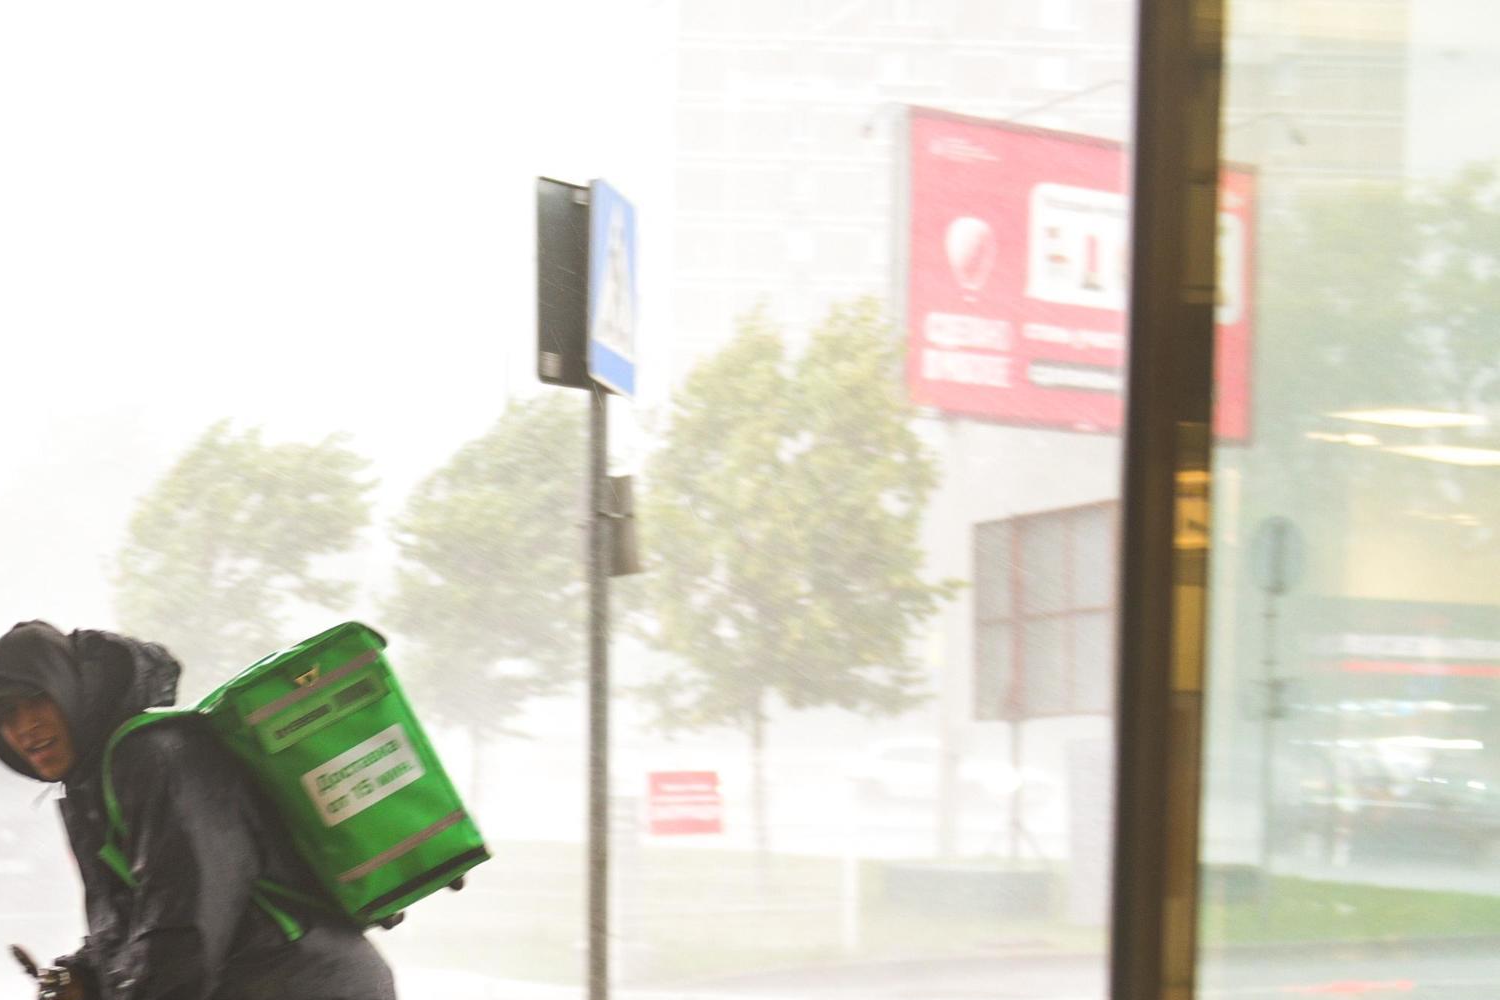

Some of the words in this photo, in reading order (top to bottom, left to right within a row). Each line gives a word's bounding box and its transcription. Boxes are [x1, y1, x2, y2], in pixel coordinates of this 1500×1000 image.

[316, 740, 400, 794] Доставка
[326, 795, 349, 814] от
[350, 778, 373, 801] 15
